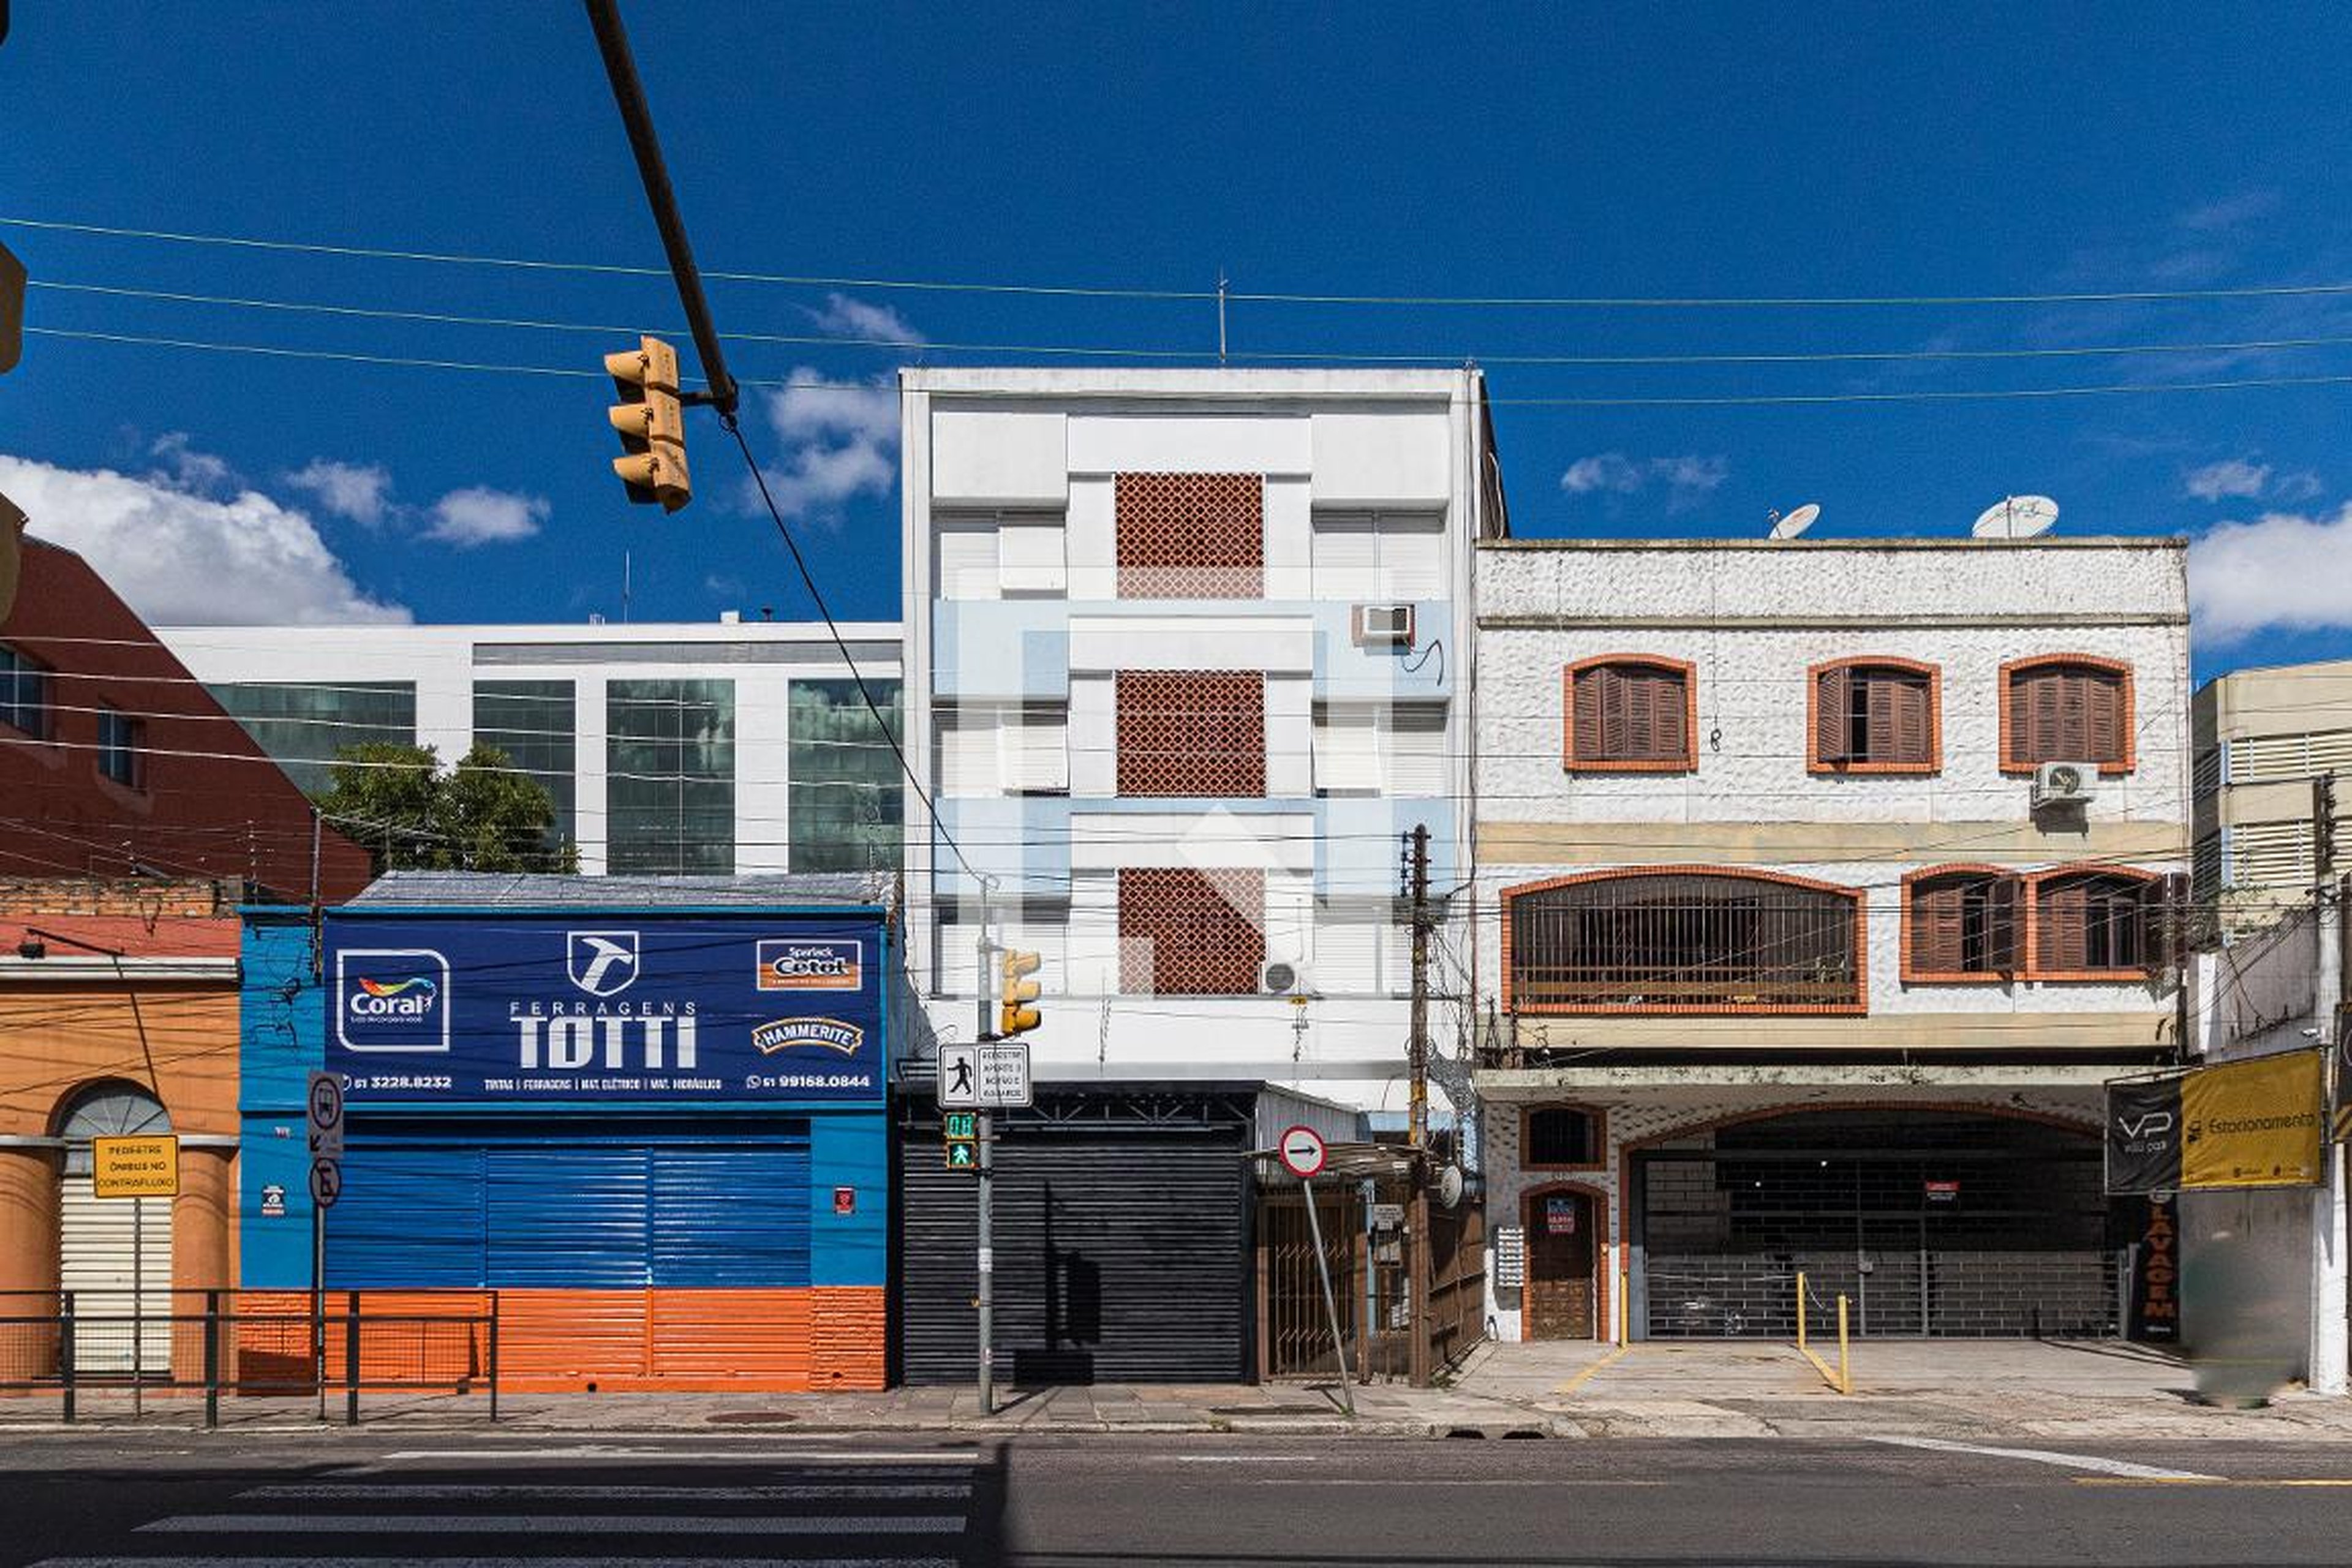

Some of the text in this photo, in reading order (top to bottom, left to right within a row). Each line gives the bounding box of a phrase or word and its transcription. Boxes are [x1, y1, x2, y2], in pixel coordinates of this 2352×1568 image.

[350, 993, 423, 1014] Coral
[510, 1002, 696, 1015] FERRAGENS
[510, 1016, 696, 1069] TOTTI
[763, 1024, 853, 1046] HAMMERITE
[779, 1076, 870, 1087] 99168.0844
[2209, 1114, 2315, 1133] Estacionamento
[150, 1161, 166, 1171] NO
[98, 1178, 174, 1188] CONTRAFLUXO
